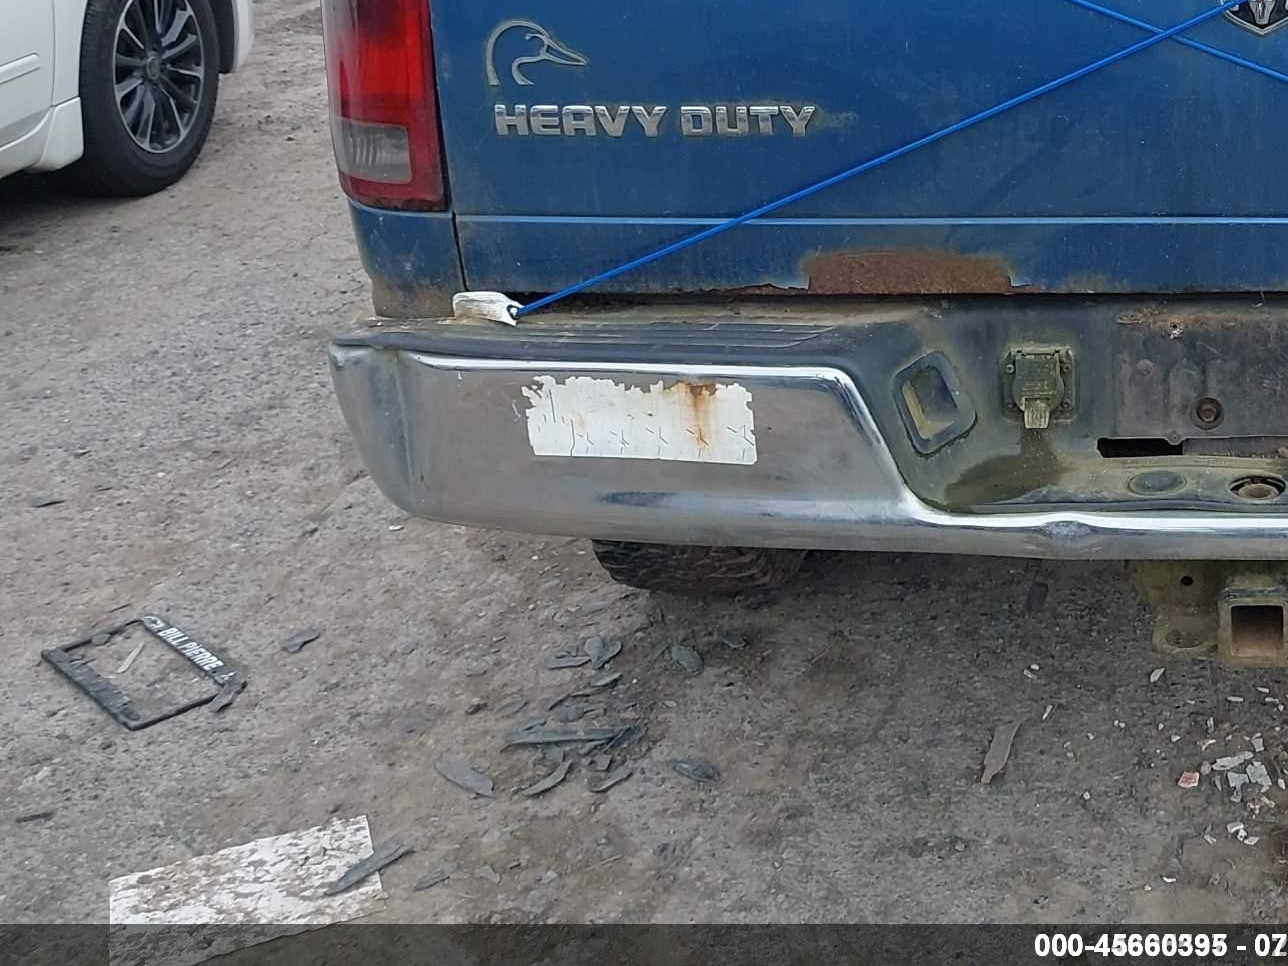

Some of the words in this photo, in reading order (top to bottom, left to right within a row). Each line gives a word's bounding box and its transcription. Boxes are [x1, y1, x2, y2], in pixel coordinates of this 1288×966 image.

[495, 104, 667, 138] HEAVY
[680, 105, 816, 138] DUTY
[157, 627, 189, 646] BILL
